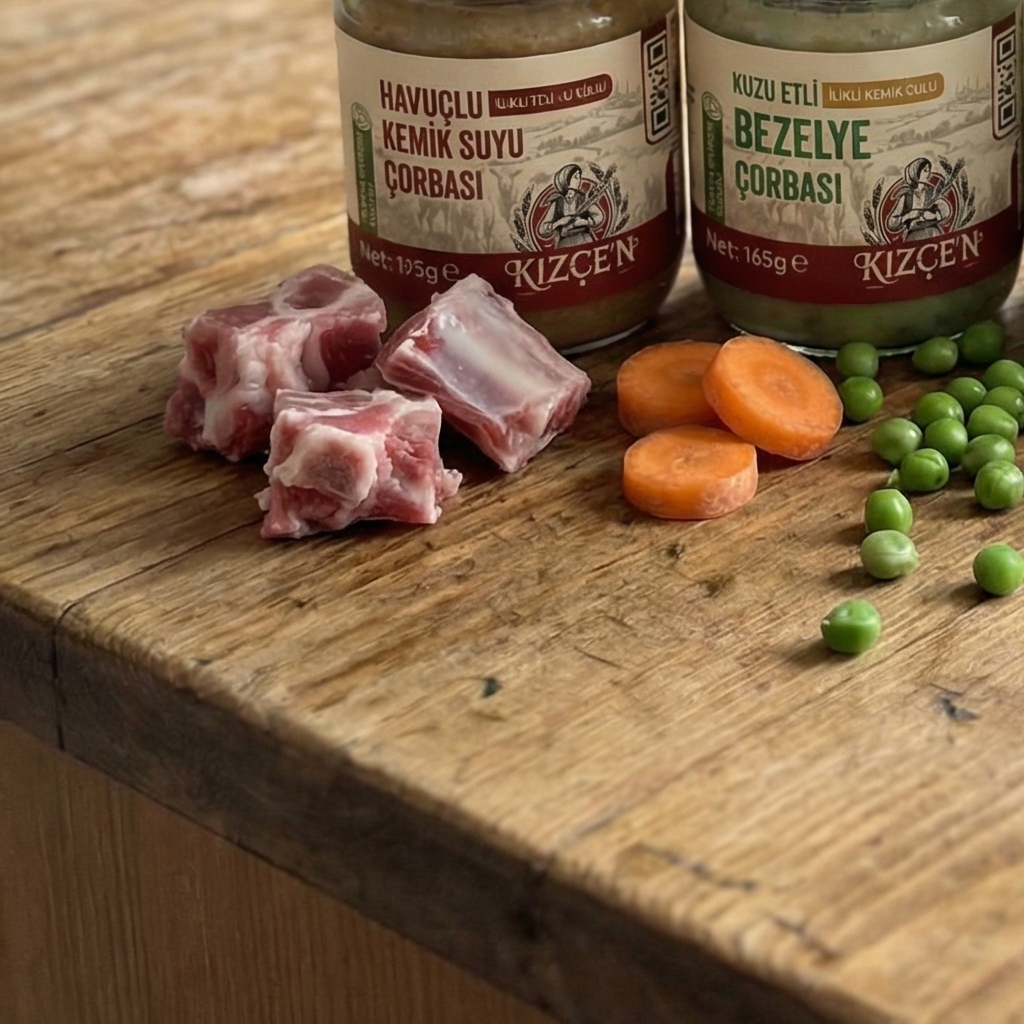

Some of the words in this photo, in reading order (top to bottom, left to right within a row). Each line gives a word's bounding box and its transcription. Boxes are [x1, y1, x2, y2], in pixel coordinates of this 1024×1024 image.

[379, 79, 483, 126] HAVUÇLU
[732, 71, 775, 102] KUZU
[781, 79, 819, 107] ETLİ
[382, 119, 452, 160] KEMİK
[459, 127, 525, 161] SUYU
[734, 107, 871, 160] BEZELYE
[384, 159, 484, 201] ÇORBASI
[735, 160, 842, 205] ÇORBASI
[360, 239, 393, 271] Net:
[744, 246, 787, 275] 165g
